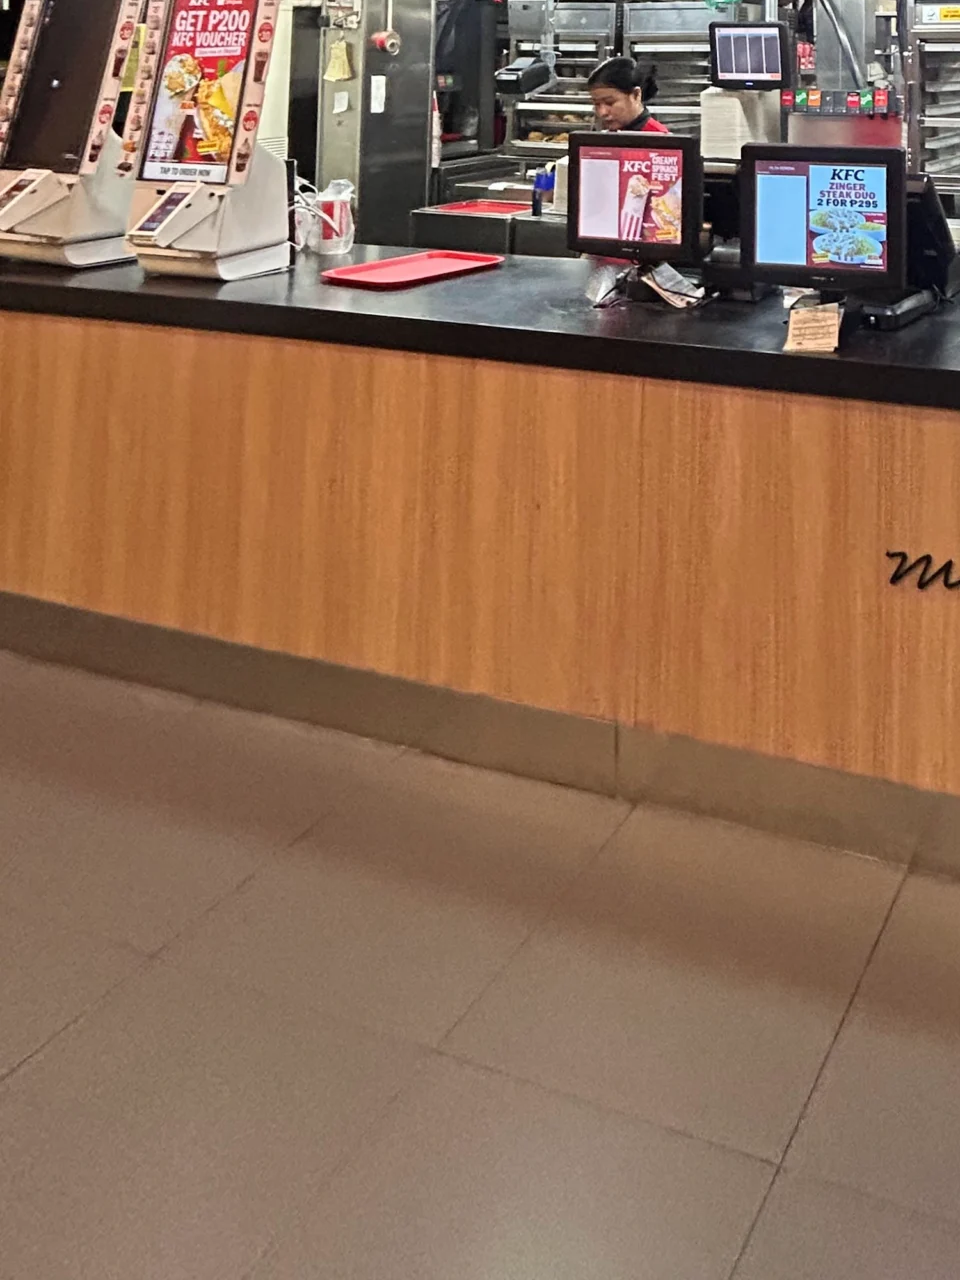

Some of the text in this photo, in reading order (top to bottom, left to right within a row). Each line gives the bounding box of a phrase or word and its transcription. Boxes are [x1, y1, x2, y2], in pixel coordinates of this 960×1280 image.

[175, 9, 251, 31] GET P200
[172, 31, 195, 47] KFC
[195, 31, 247, 47] VOUCHER
[623, 160, 651, 173] KFC
[651, 173, 678, 181] FEST
[830, 168, 866, 181] KFC
[829, 182, 866, 191] ZINGER
[819, 190, 876, 200] STEAK DUO
[817, 198, 824, 206] 2
[826, 199, 848, 207] FOR
